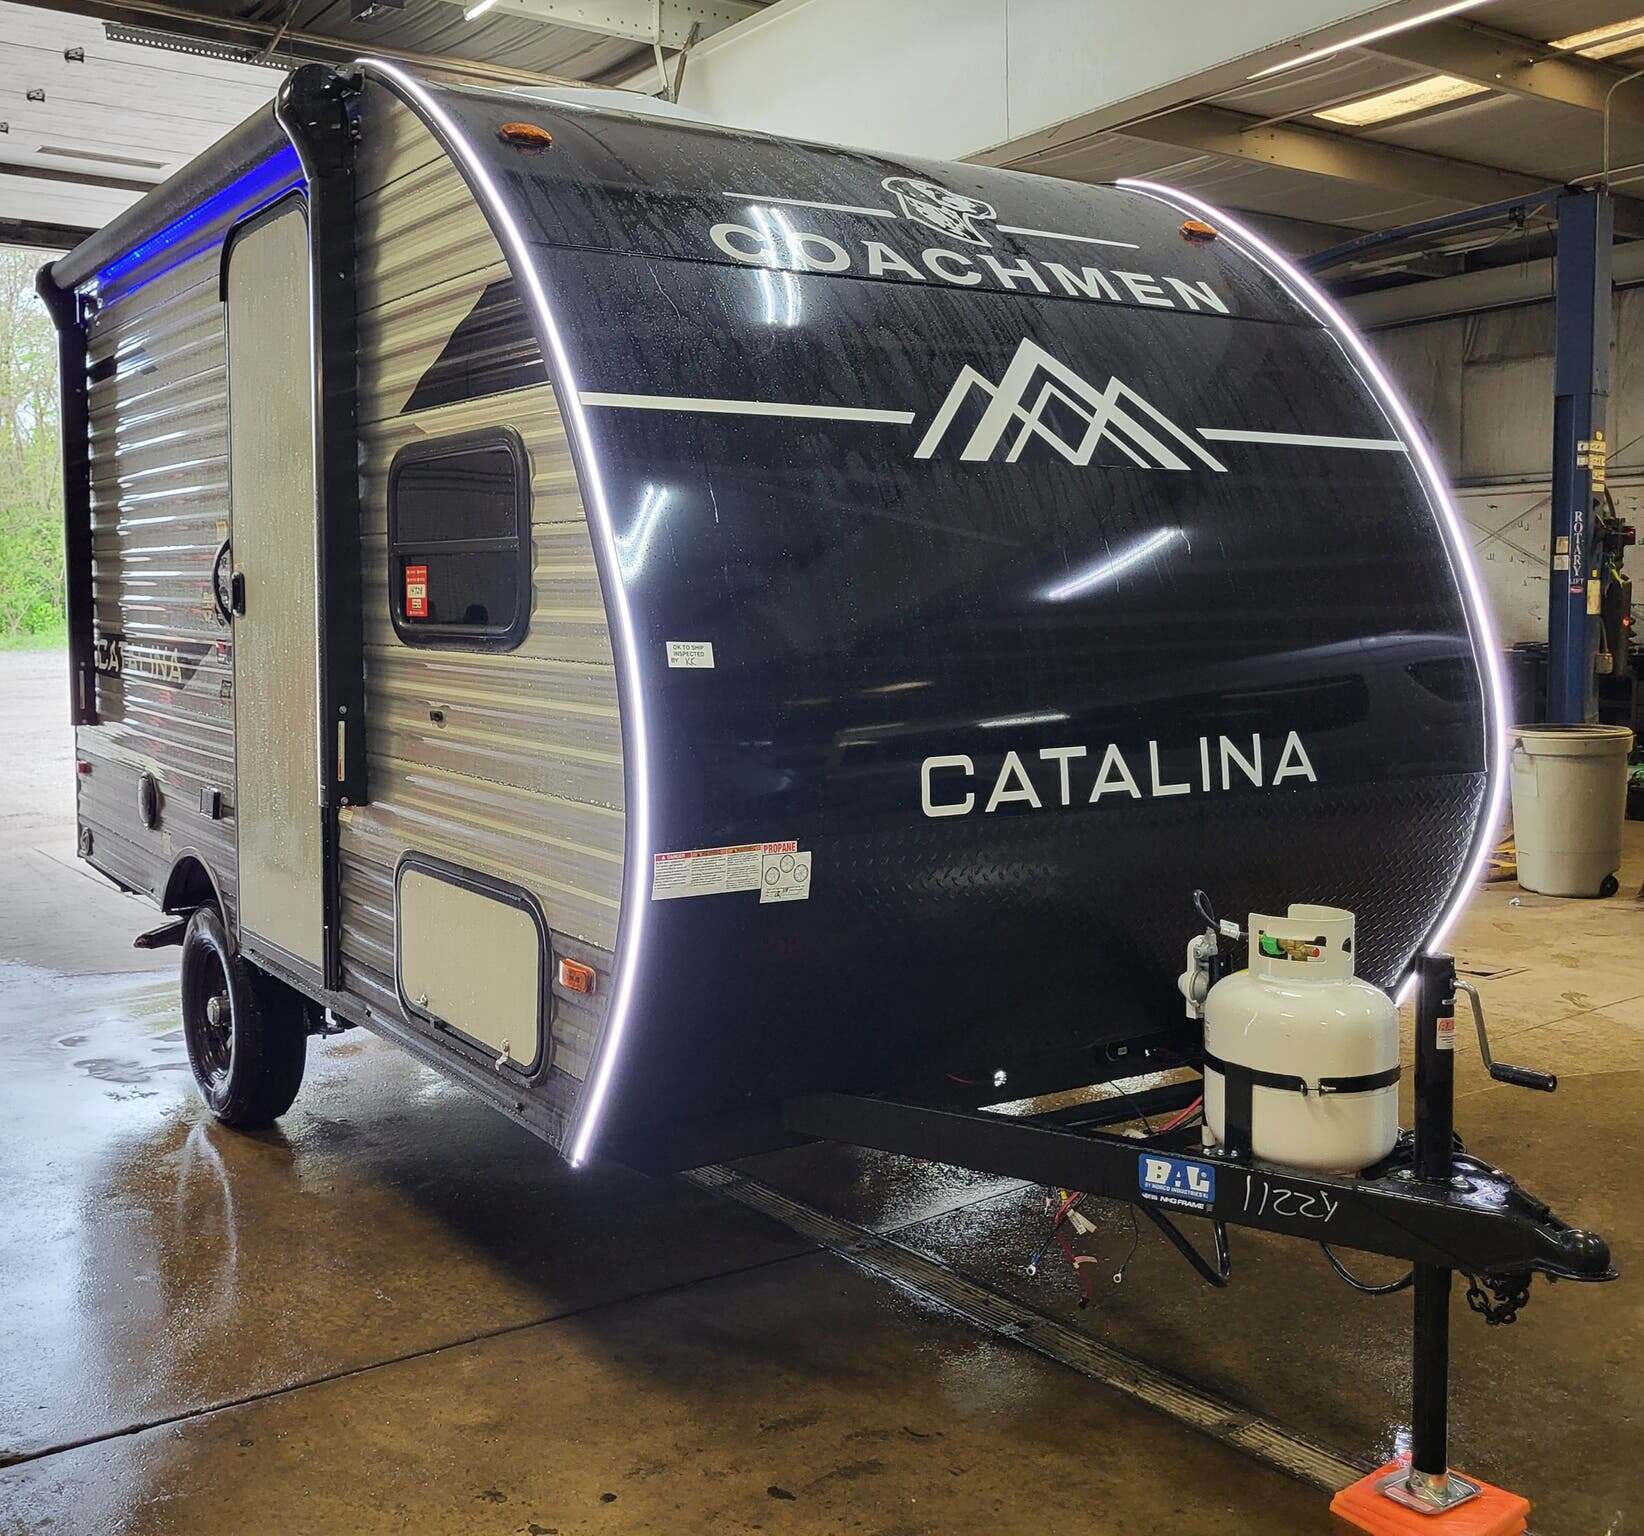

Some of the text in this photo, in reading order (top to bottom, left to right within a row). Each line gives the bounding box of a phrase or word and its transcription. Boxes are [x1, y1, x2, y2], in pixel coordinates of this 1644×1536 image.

[709, 223, 1231, 314] COACHMEN
[1573, 510, 1584, 577] ROTARY
[921, 731, 1318, 818] CATALINA
[763, 842, 796, 854] PROPANE
[1145, 1158, 1210, 1192] BAL
[1170, 1186, 1203, 1198] INDUSTRIES
[1177, 1199, 1205, 1210] FRAME
